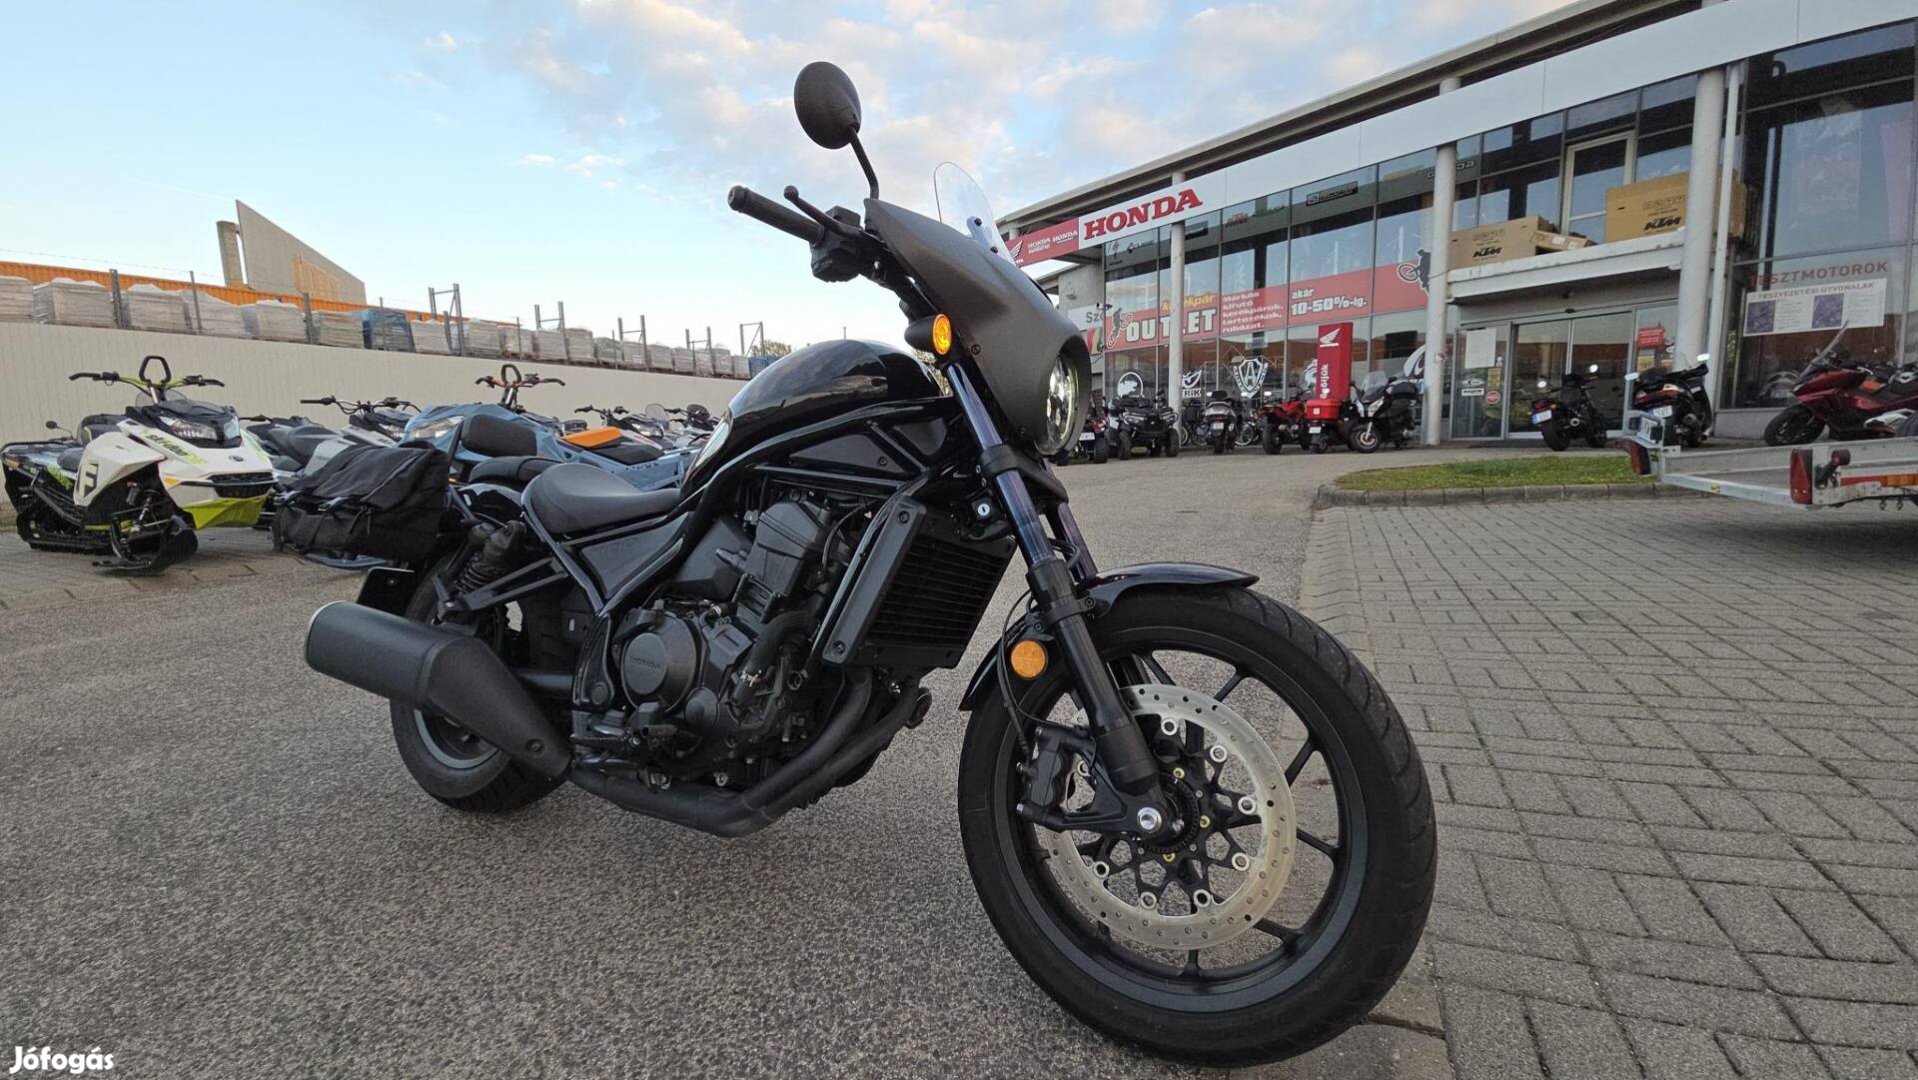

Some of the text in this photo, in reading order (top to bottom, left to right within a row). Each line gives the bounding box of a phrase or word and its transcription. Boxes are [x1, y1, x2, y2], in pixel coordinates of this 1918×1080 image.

[1084, 188, 1203, 241] HONDA
[1643, 216, 1682, 231] KTM
[1027, 237, 1051, 249] HONDA
[1052, 229, 1078, 243] HONDA
[1472, 246, 1502, 258] KTM
[1291, 287, 1315, 300] akár
[1291, 296, 1368, 316] 10-50%-ig.
[1125, 308, 1217, 343] OUTET
